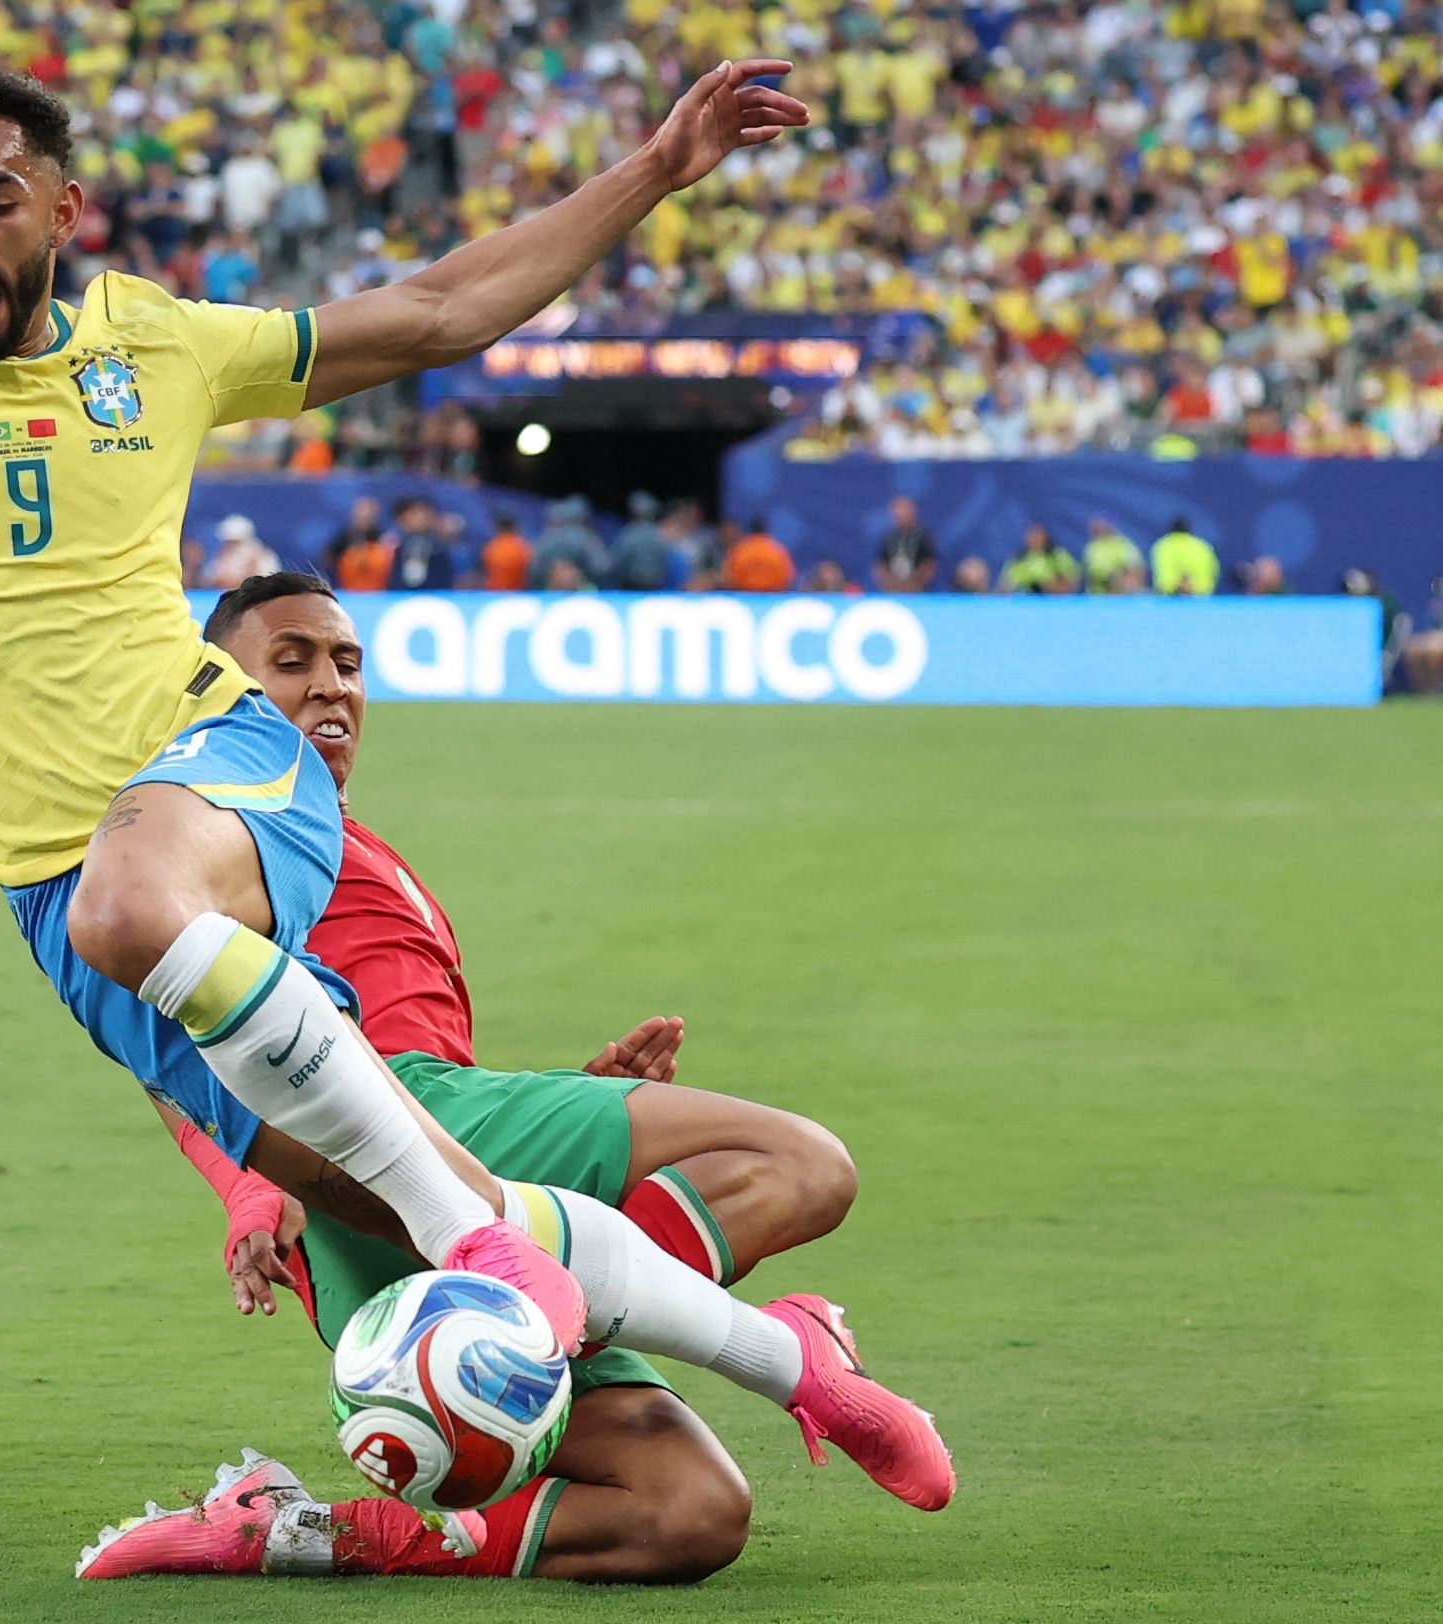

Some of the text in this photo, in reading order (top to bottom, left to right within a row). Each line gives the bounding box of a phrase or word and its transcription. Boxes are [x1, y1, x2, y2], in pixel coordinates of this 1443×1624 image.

[97, 386, 121, 398] CBF
[90, 436, 155, 453] BRASIL
[5, 458, 53, 557] 9
[372, 595, 929, 701] aramco
[288, 1034, 336, 1090] BRASIL
[598, 1308, 629, 1344] ASIL
